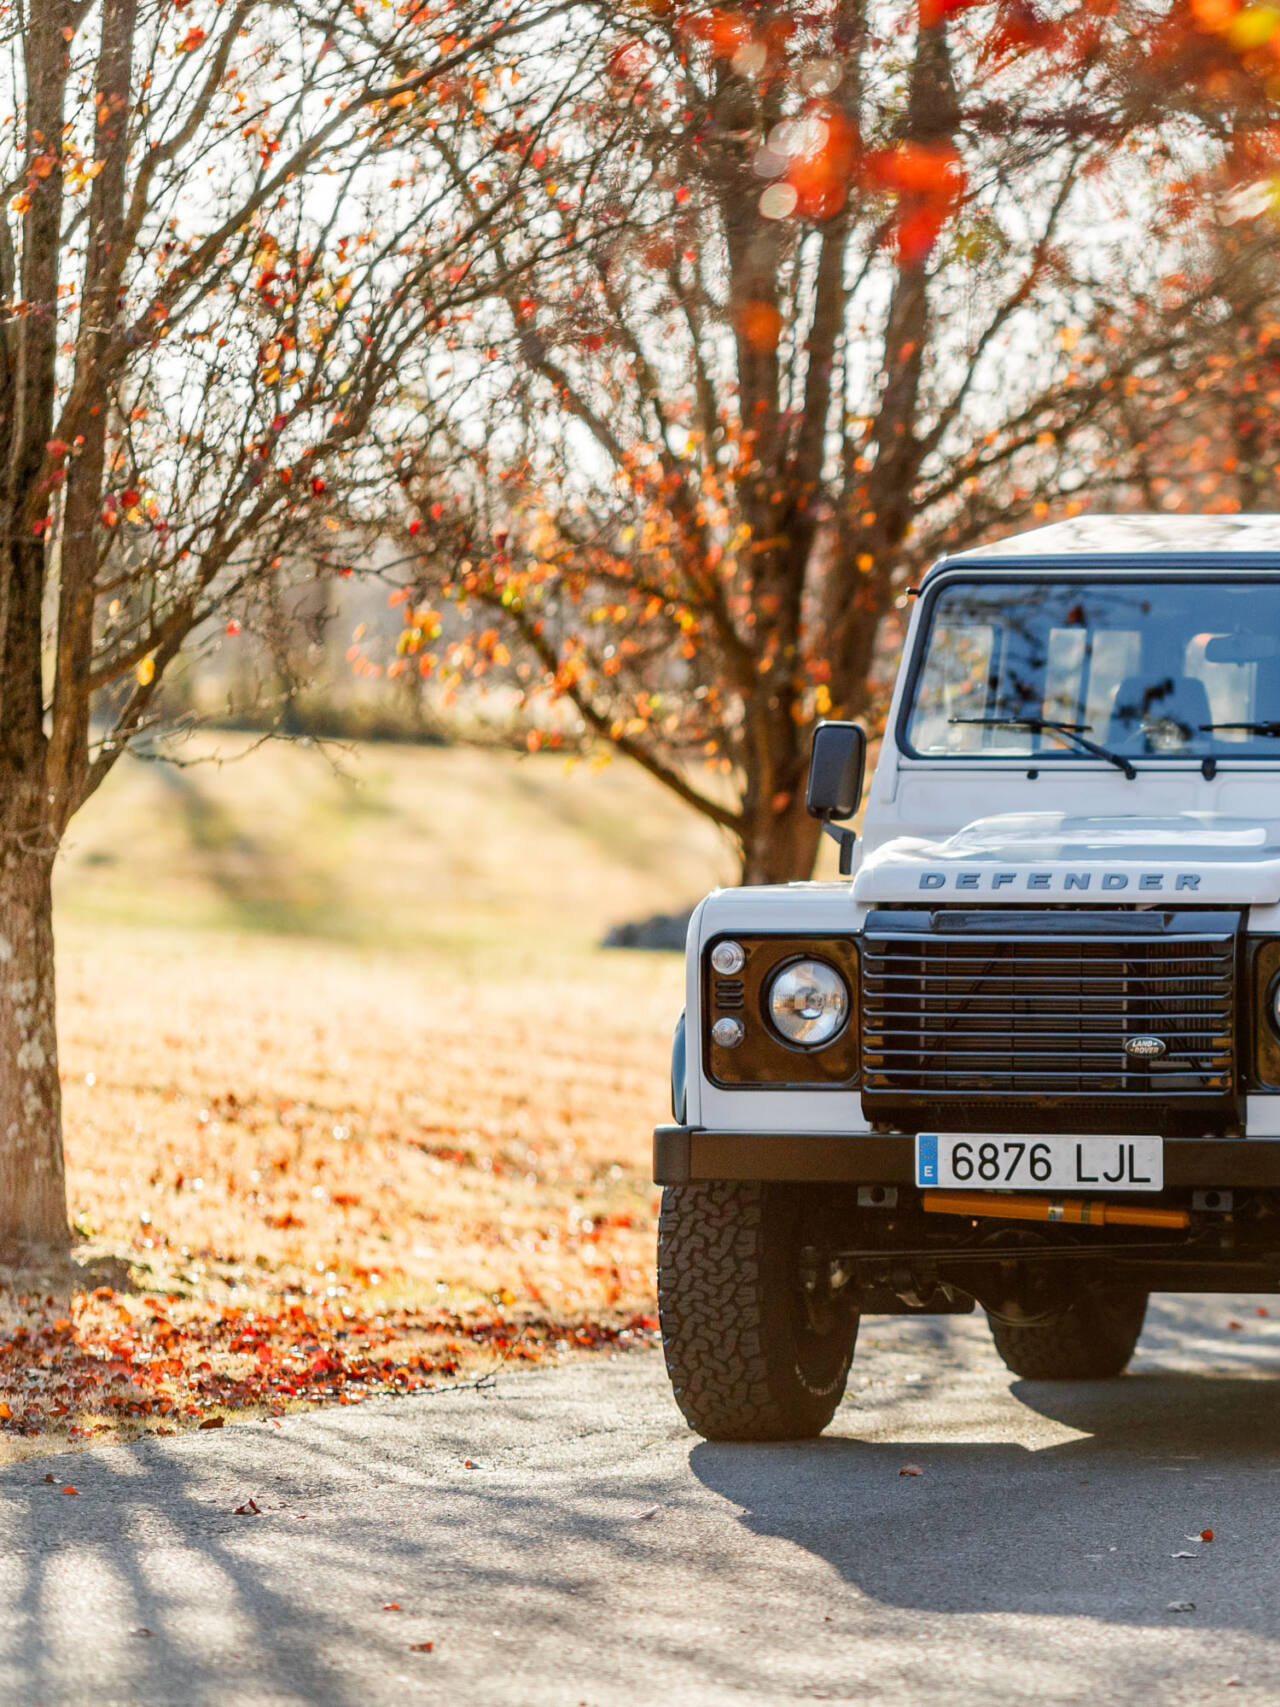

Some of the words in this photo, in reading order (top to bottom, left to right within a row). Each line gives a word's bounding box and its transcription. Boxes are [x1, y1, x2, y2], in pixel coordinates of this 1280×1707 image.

[918, 872, 1202, 891] DEFENDER
[924, 1166, 933, 1177] E
[952, 1142, 1052, 1181] 6876
[1076, 1143, 1151, 1183] LJL
